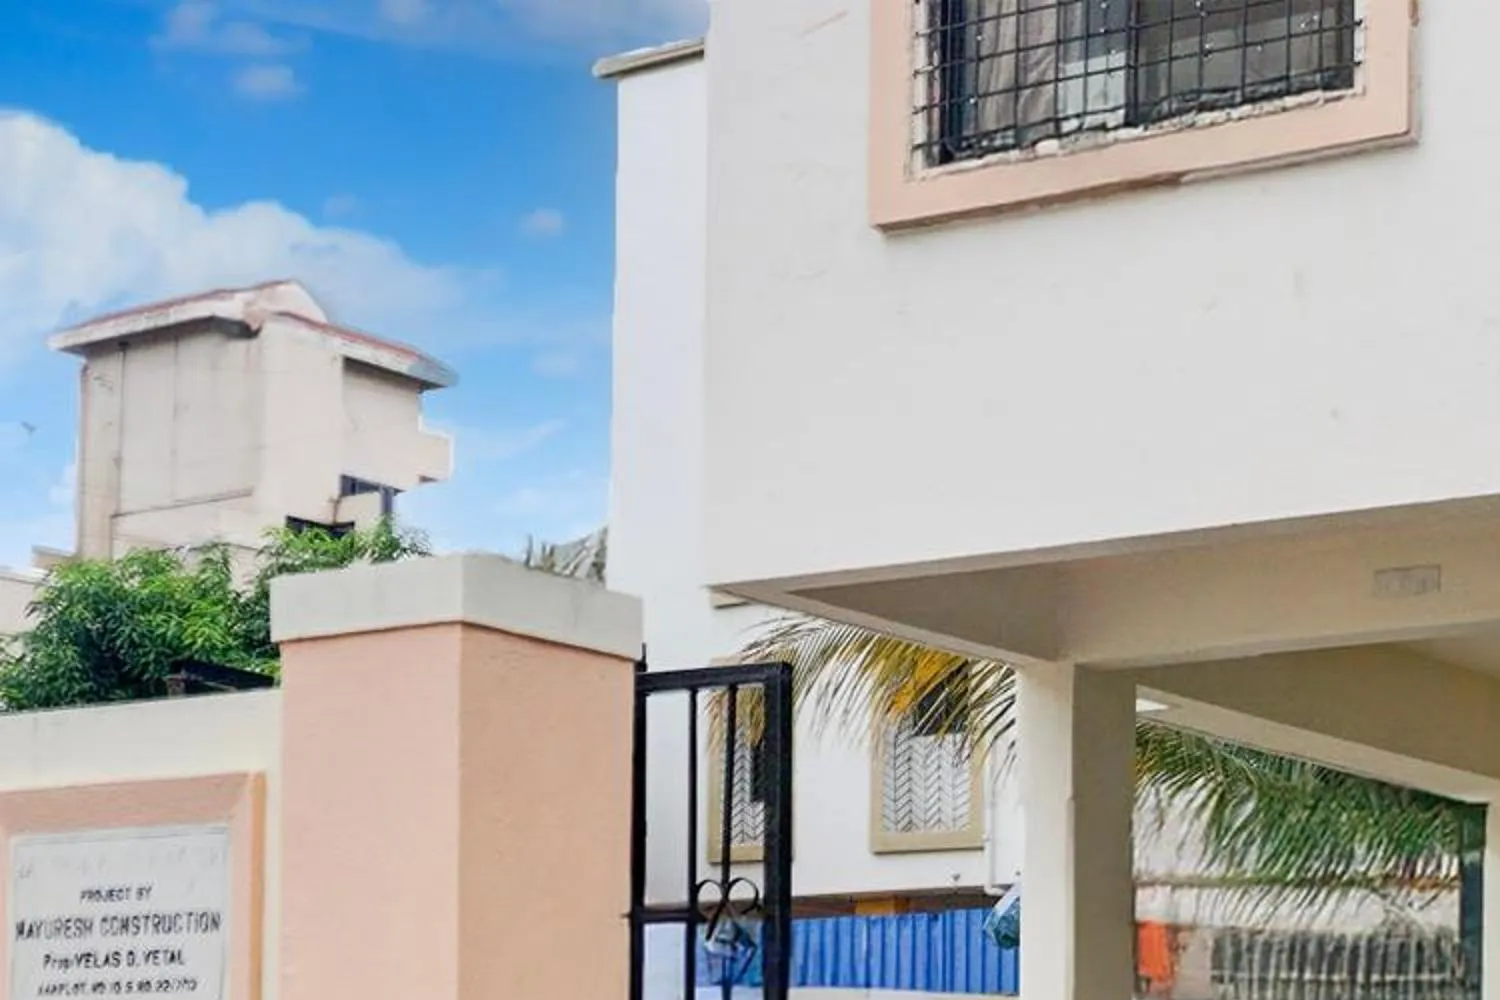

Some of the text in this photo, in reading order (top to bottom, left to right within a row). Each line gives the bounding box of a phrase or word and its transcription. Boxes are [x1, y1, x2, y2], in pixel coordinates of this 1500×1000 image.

[79, 884, 153, 905] PROJECT BY
[15, 911, 222, 941] MAYURESH CONSTRUCTION
